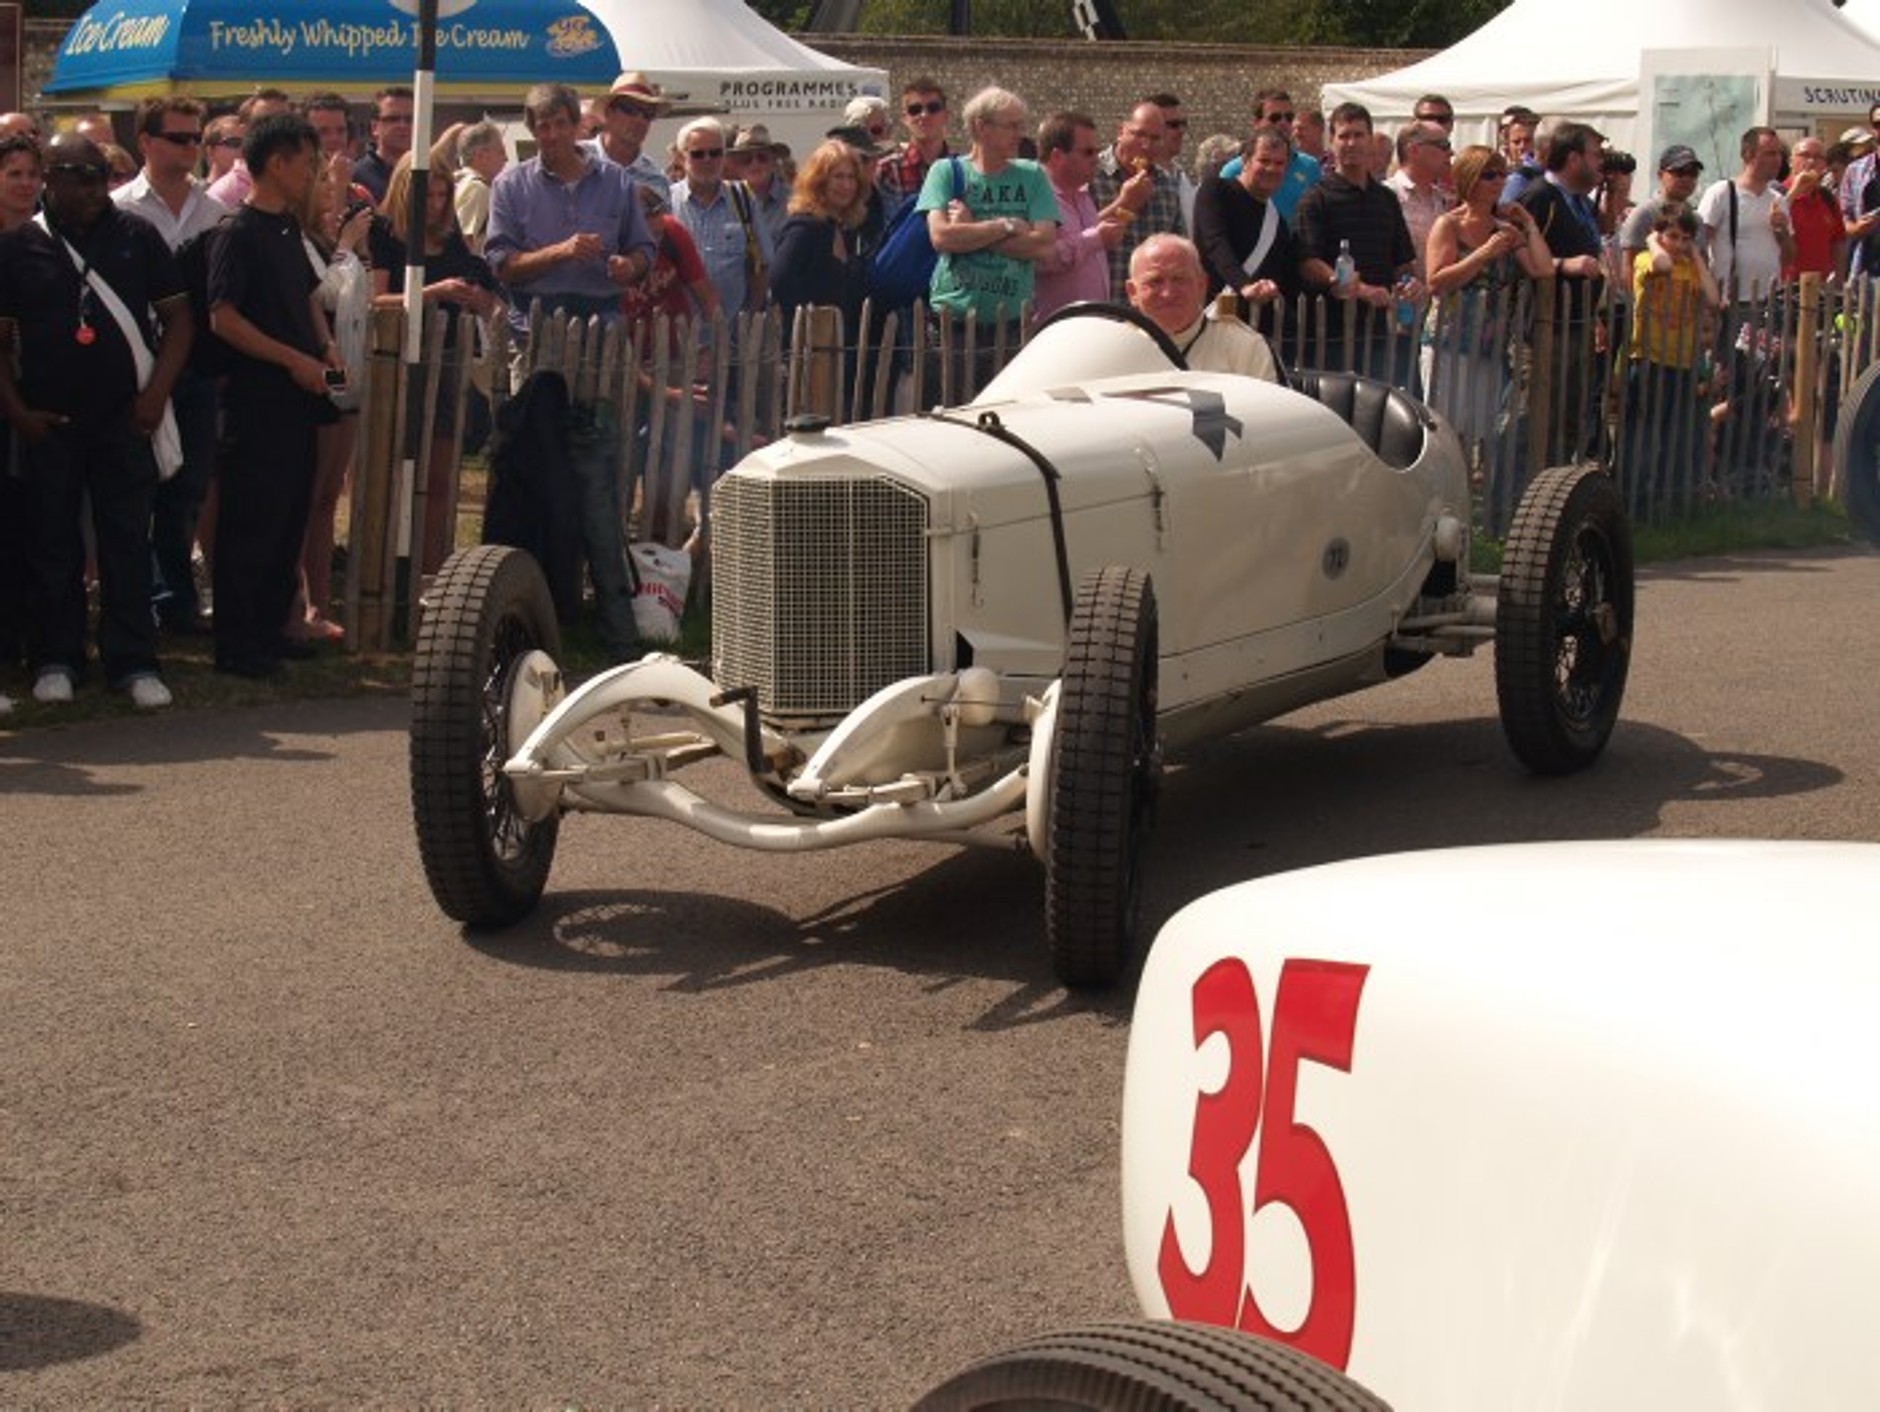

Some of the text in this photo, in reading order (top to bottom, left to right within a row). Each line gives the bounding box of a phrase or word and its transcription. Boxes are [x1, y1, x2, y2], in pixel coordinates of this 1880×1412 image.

[64, 10, 170, 55] Ice Cream
[208, 18, 297, 55] Freshly
[300, 18, 407, 57] Whipped
[410, 22, 450, 48] Ie
[451, 23, 531, 49] Cream
[719, 80, 858, 97] PROGRAMMES
[1804, 85, 1880, 104] SCRUTIN
[1157, 956, 1371, 1373] 35
